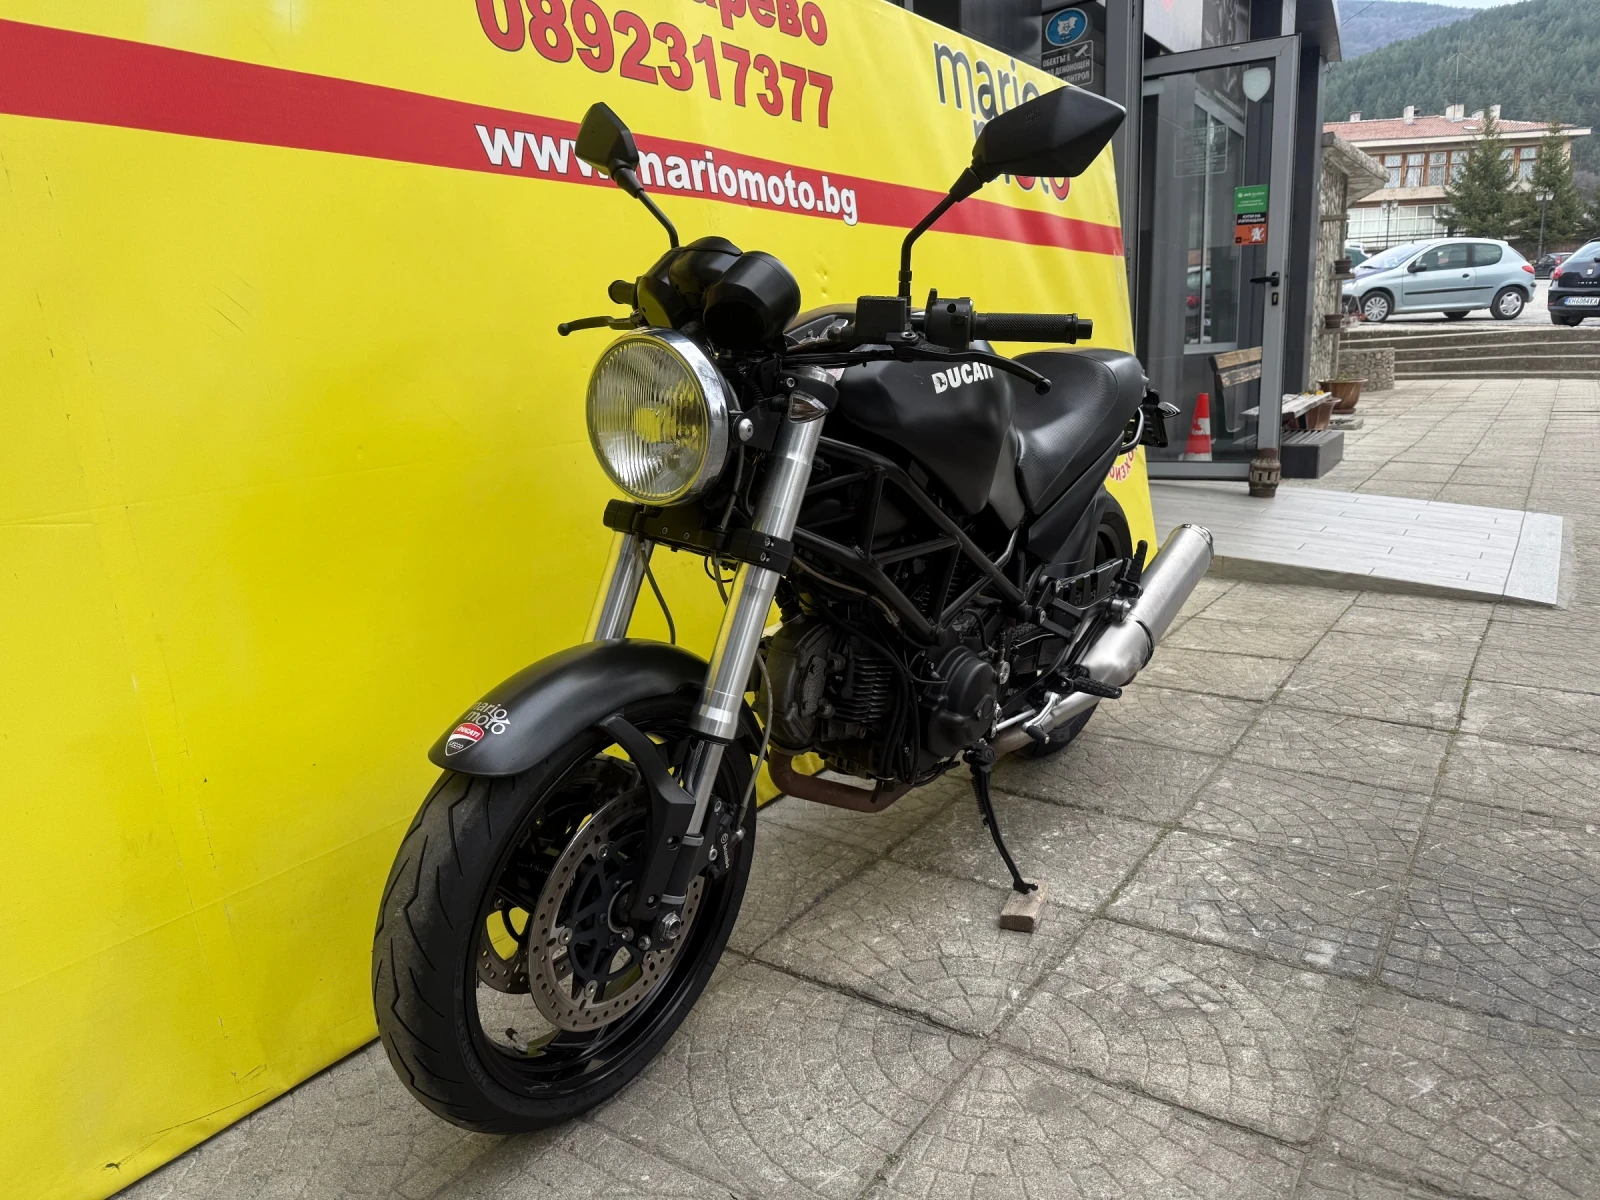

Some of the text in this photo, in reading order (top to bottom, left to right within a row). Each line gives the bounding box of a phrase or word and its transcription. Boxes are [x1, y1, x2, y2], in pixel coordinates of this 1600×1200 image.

[691, 0, 828, 46] рево
[476, 0, 833, 128] 0892317377
[1042, 53, 1071, 67] ОБЕКТЪТ Е
[1055, 59, 1090, 77] ДЕНОНОЩЕН
[474, 123, 858, 226] wwmariomoto.bg
[931, 361, 994, 394] DUCATI
[470, 701, 508, 720] mario
[456, 726, 481, 738] DUCATI
[464, 711, 506, 735] moto
